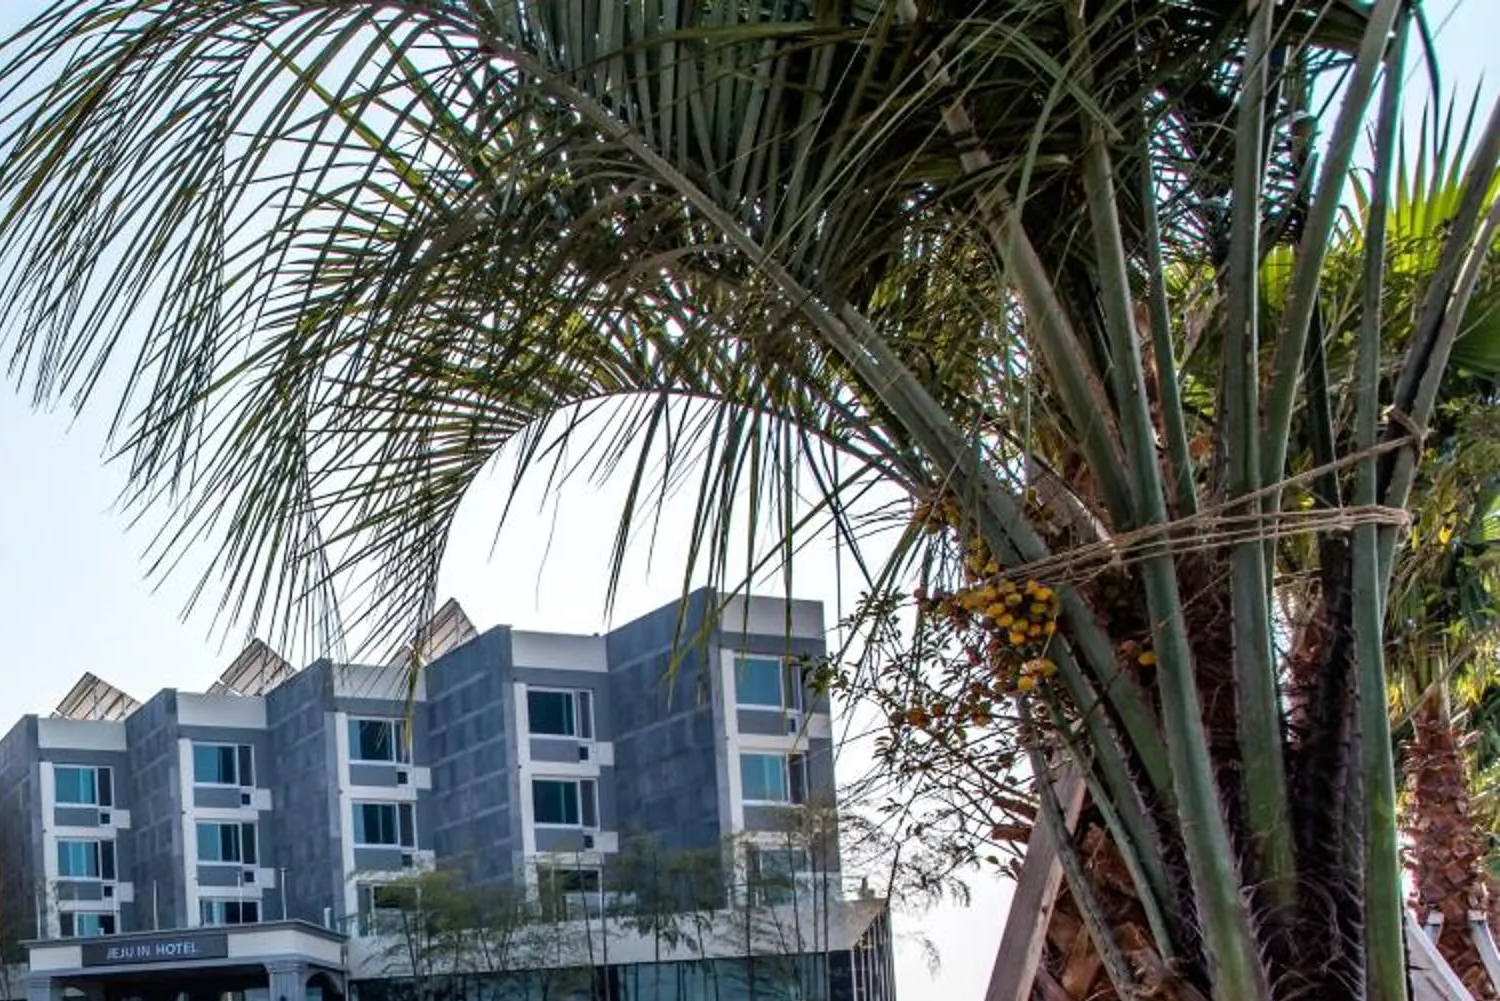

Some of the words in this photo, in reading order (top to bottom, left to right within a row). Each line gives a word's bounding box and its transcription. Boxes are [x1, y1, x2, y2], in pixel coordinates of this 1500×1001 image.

[106, 946, 135, 960] JEJU
[137, 943, 151, 957] IN
[155, 940, 197, 956] HOTEL
